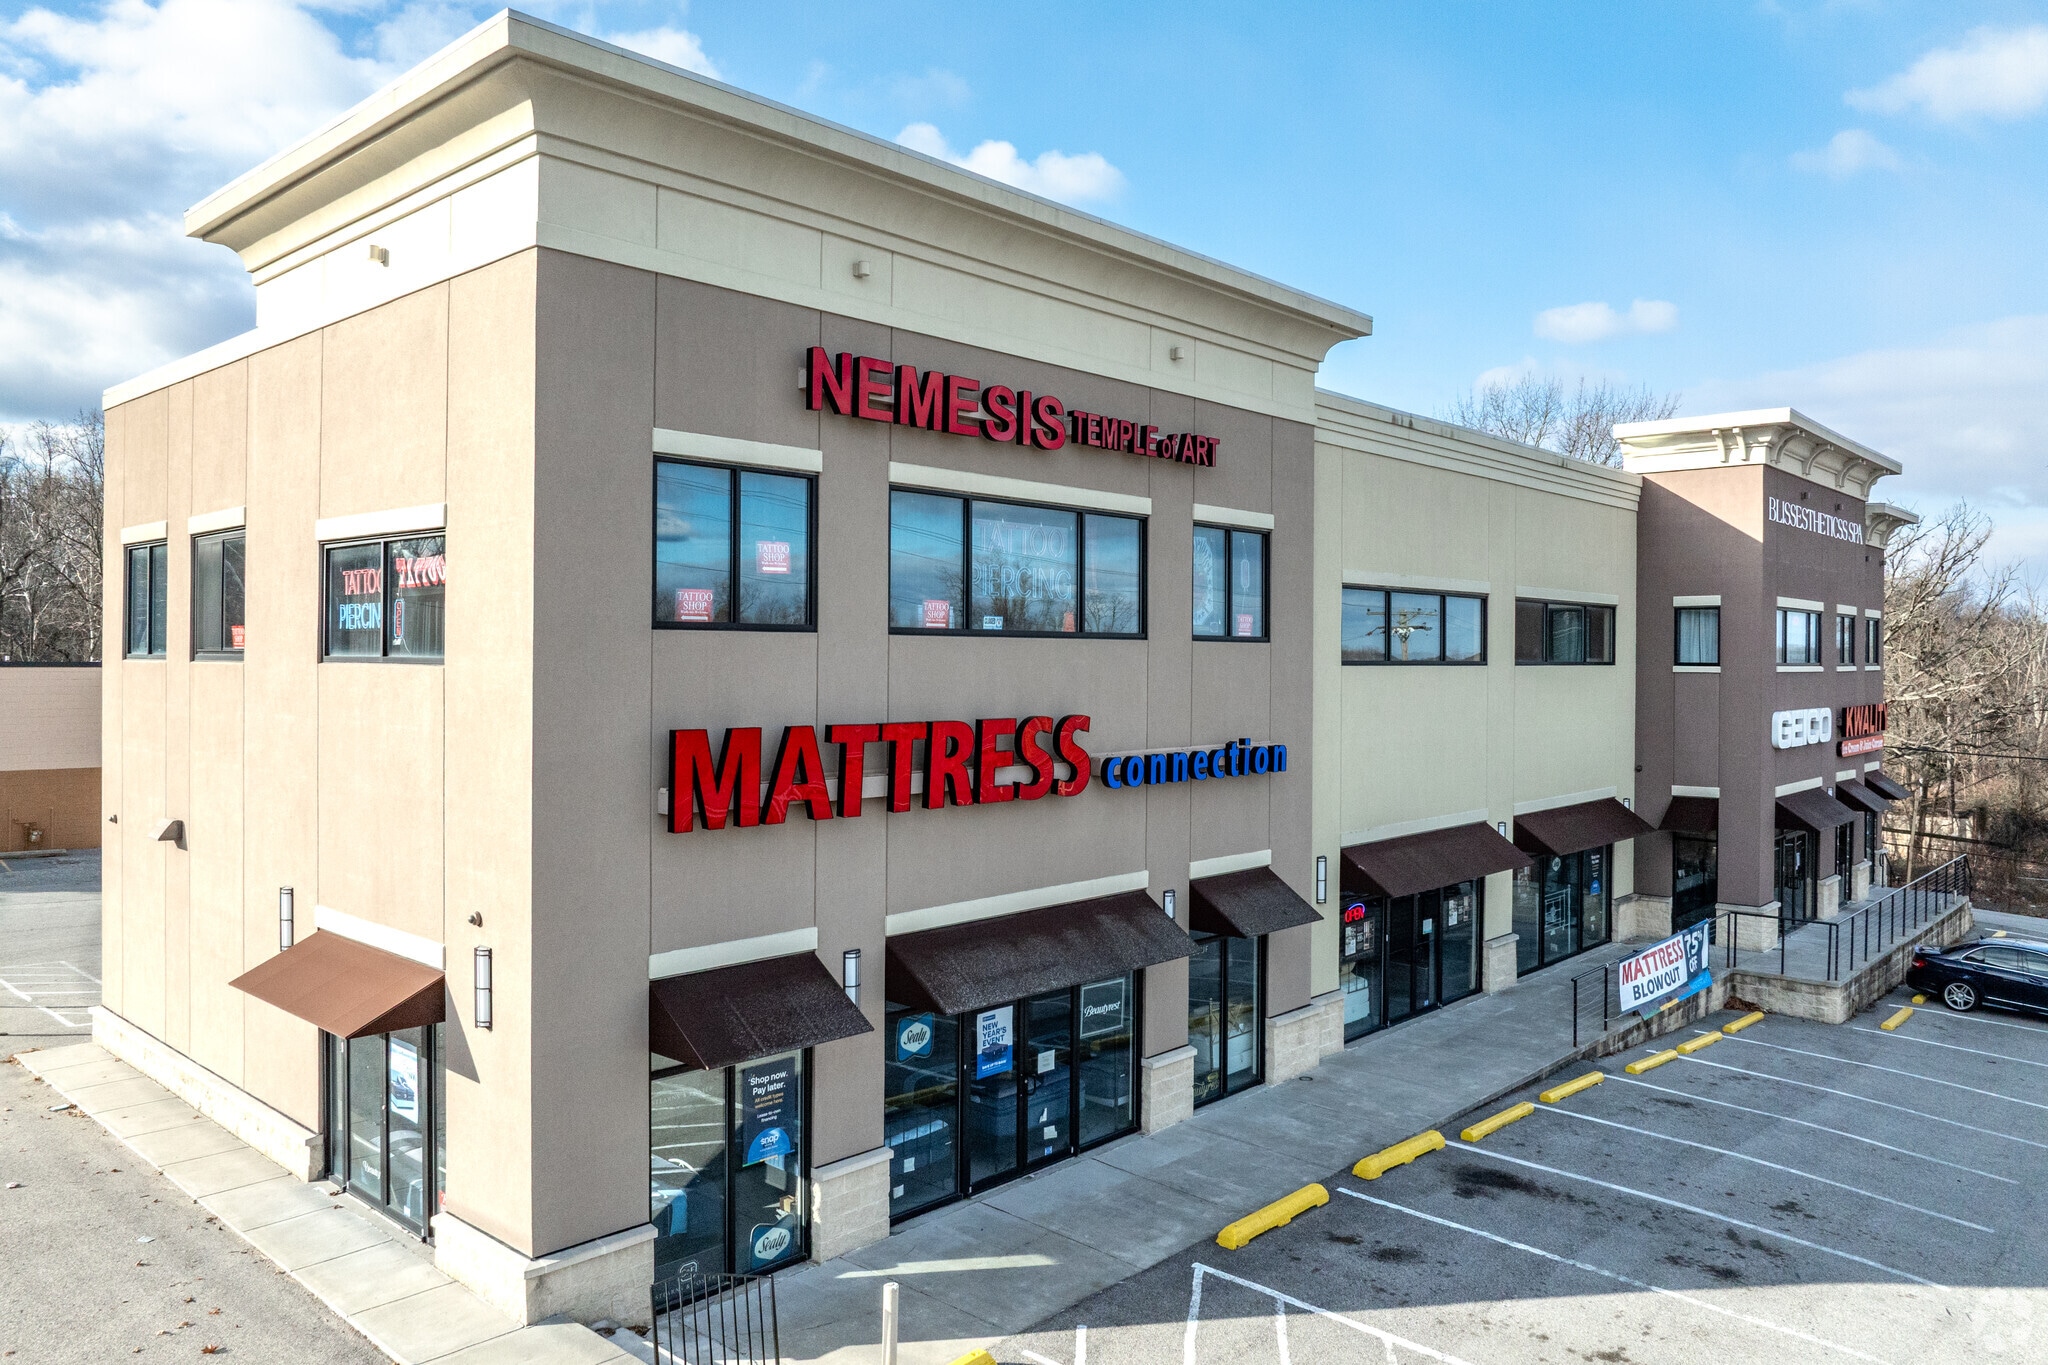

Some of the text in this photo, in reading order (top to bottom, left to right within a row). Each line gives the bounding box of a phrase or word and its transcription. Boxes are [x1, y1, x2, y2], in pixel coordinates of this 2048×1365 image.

[806, 346, 1220, 467] NEMESIS TEMPLE of ART
[975, 519, 1065, 558] TATTOO
[1848, 521, 1864, 545] SPA
[757, 543, 790, 553] TATTOO
[763, 553, 785, 562] SHOP
[972, 563, 1072, 600] PIERCING
[677, 591, 713, 601] TATTOO
[683, 601, 707, 611] SHOP
[924, 602, 949, 611] TATTOO
[927, 610, 945, 619] SHOP
[1772, 707, 1832, 749] GEICO
[1843, 703, 1888, 738] KWALITY
[667, 714, 1287, 834] MATTRESS connection
[1344, 905, 1365, 923] OPEN
[1622, 939, 1684, 986] MATTRESS
[1688, 955, 1698, 973] OFF
[1632, 966, 1681, 1001] BLOWOUT
[1084, 1000, 1121, 1018] Beautyrest
[982, 1020, 999, 1032] NEW
[982, 1026, 1007, 1040] YEAR'S
[903, 1027, 928, 1045] Sealy
[982, 1034, 1005, 1048] EVENT
[750, 1070, 789, 1086] Shop now.
[752, 1081, 786, 1096] Pay later.
[761, 1115, 777, 1123] financing
[760, 1134, 779, 1146] snap
[758, 1231, 787, 1254] Sealy
